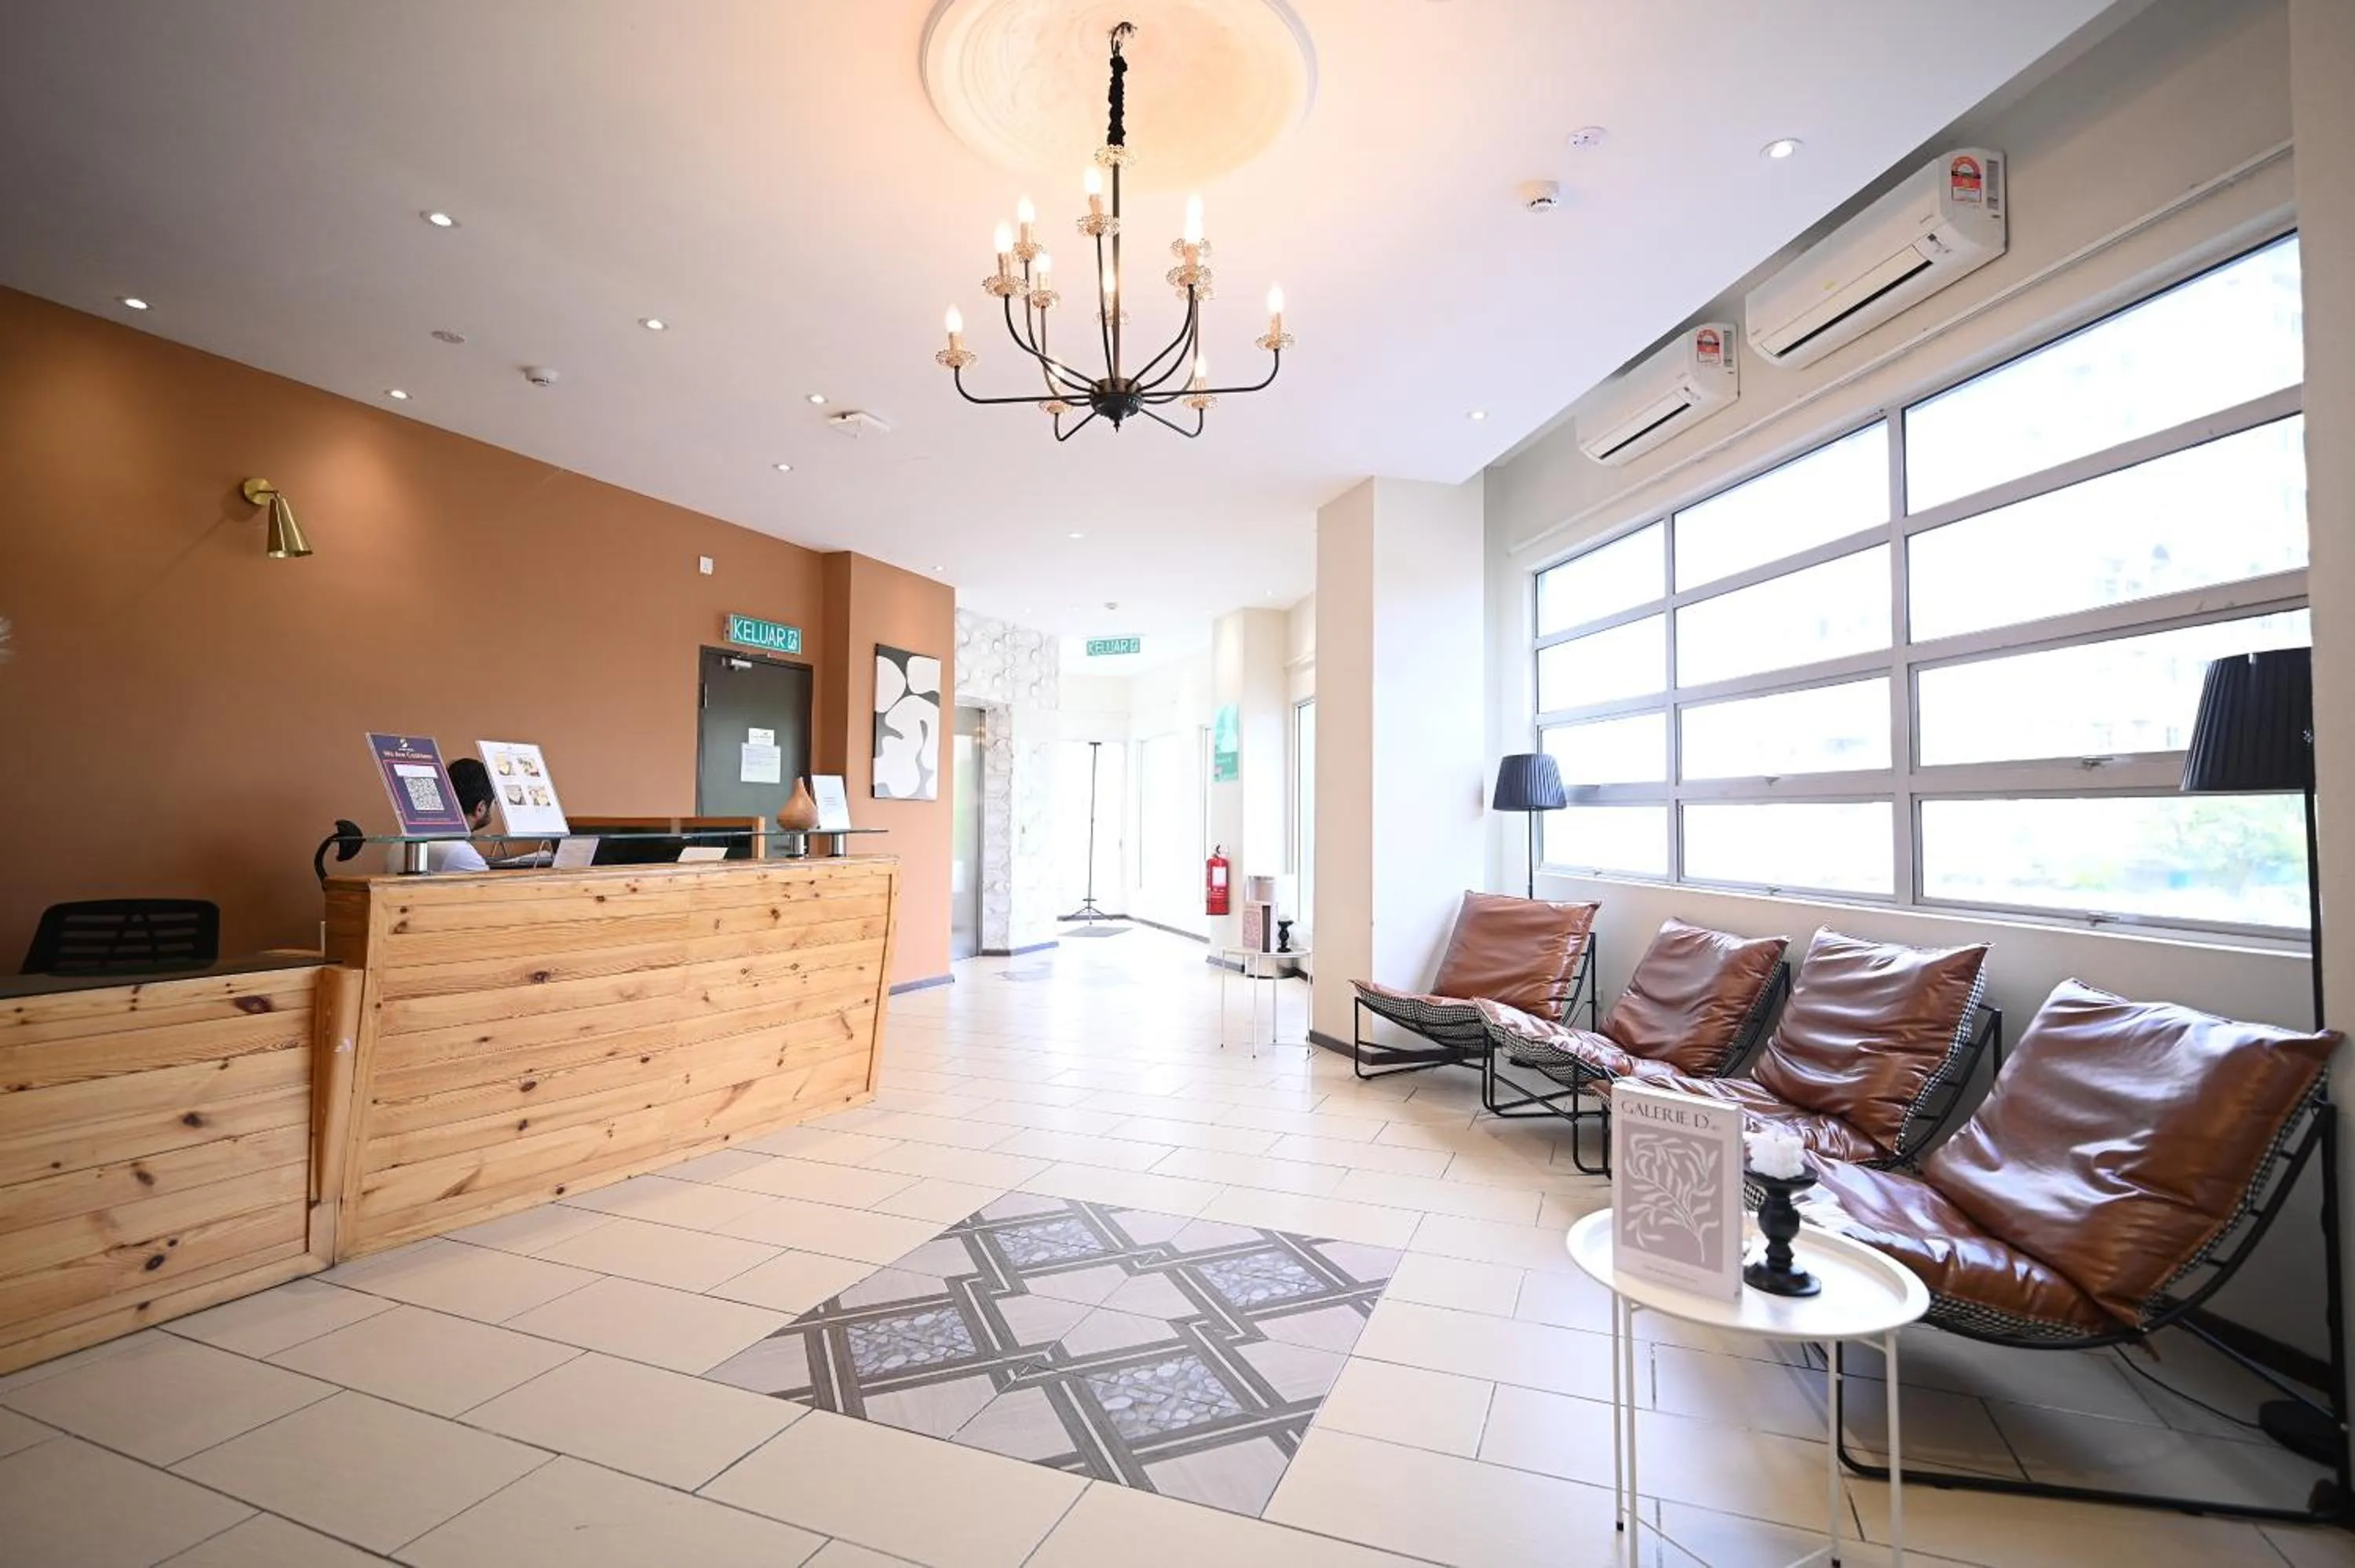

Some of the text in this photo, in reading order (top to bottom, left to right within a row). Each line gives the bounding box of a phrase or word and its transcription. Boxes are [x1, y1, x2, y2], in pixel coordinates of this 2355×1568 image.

[734, 618, 786, 647] KELUAR
[1087, 640, 1129, 655] KELUAR
[1621, 1100, 1689, 1125] GALERIE
